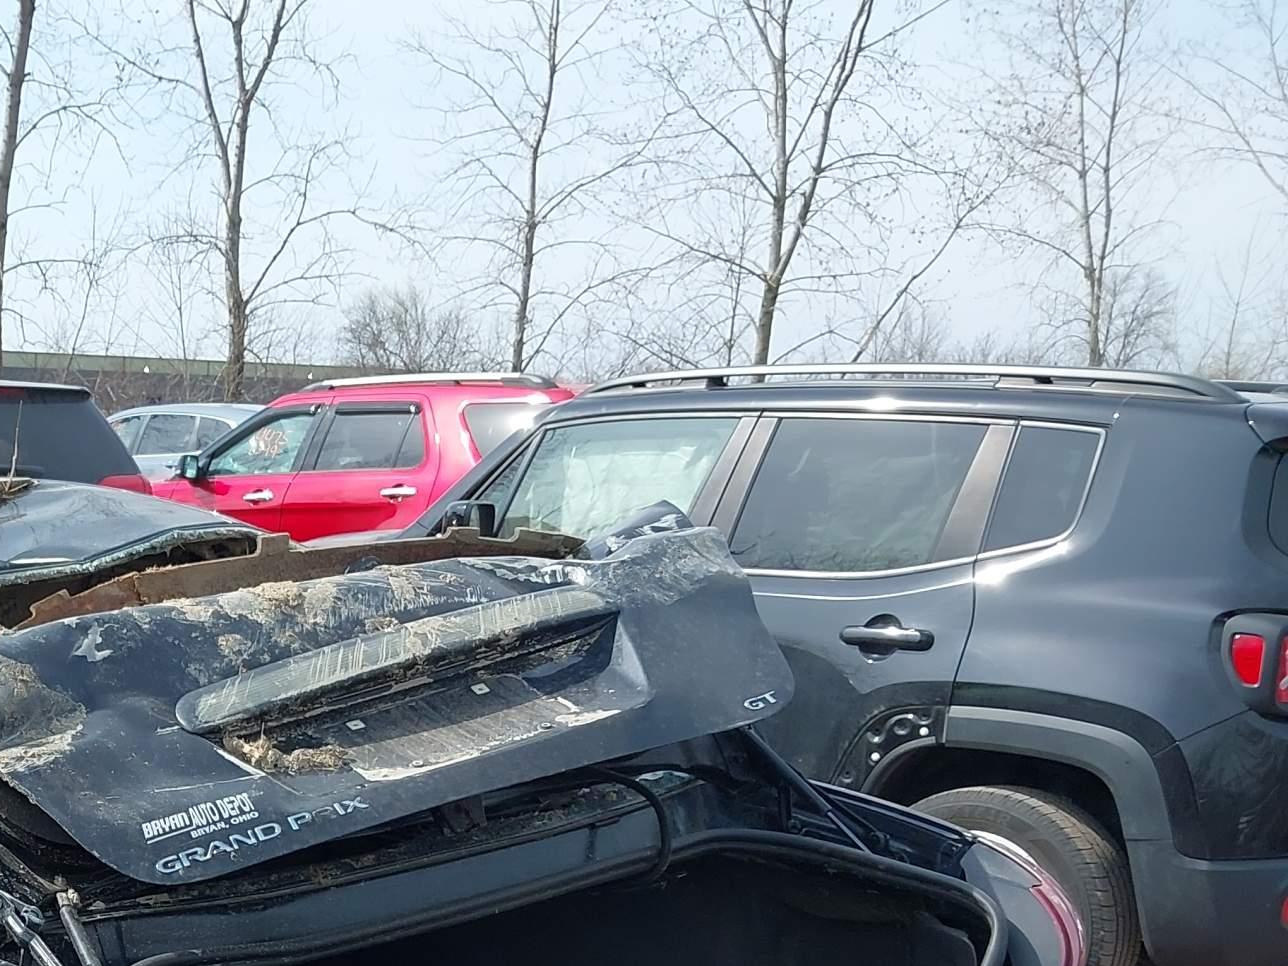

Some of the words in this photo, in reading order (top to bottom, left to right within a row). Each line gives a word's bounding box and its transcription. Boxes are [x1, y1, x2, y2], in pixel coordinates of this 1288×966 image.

[743, 690, 777, 710] GT
[142, 811, 191, 839] BRYAN
[189, 801, 221, 828] AUTO
[215, 792, 255, 819] DEPOT
[190, 821, 230, 839] BRYAN,
[230, 811, 260, 825] OHIO
[155, 822, 282, 875] GRAND
